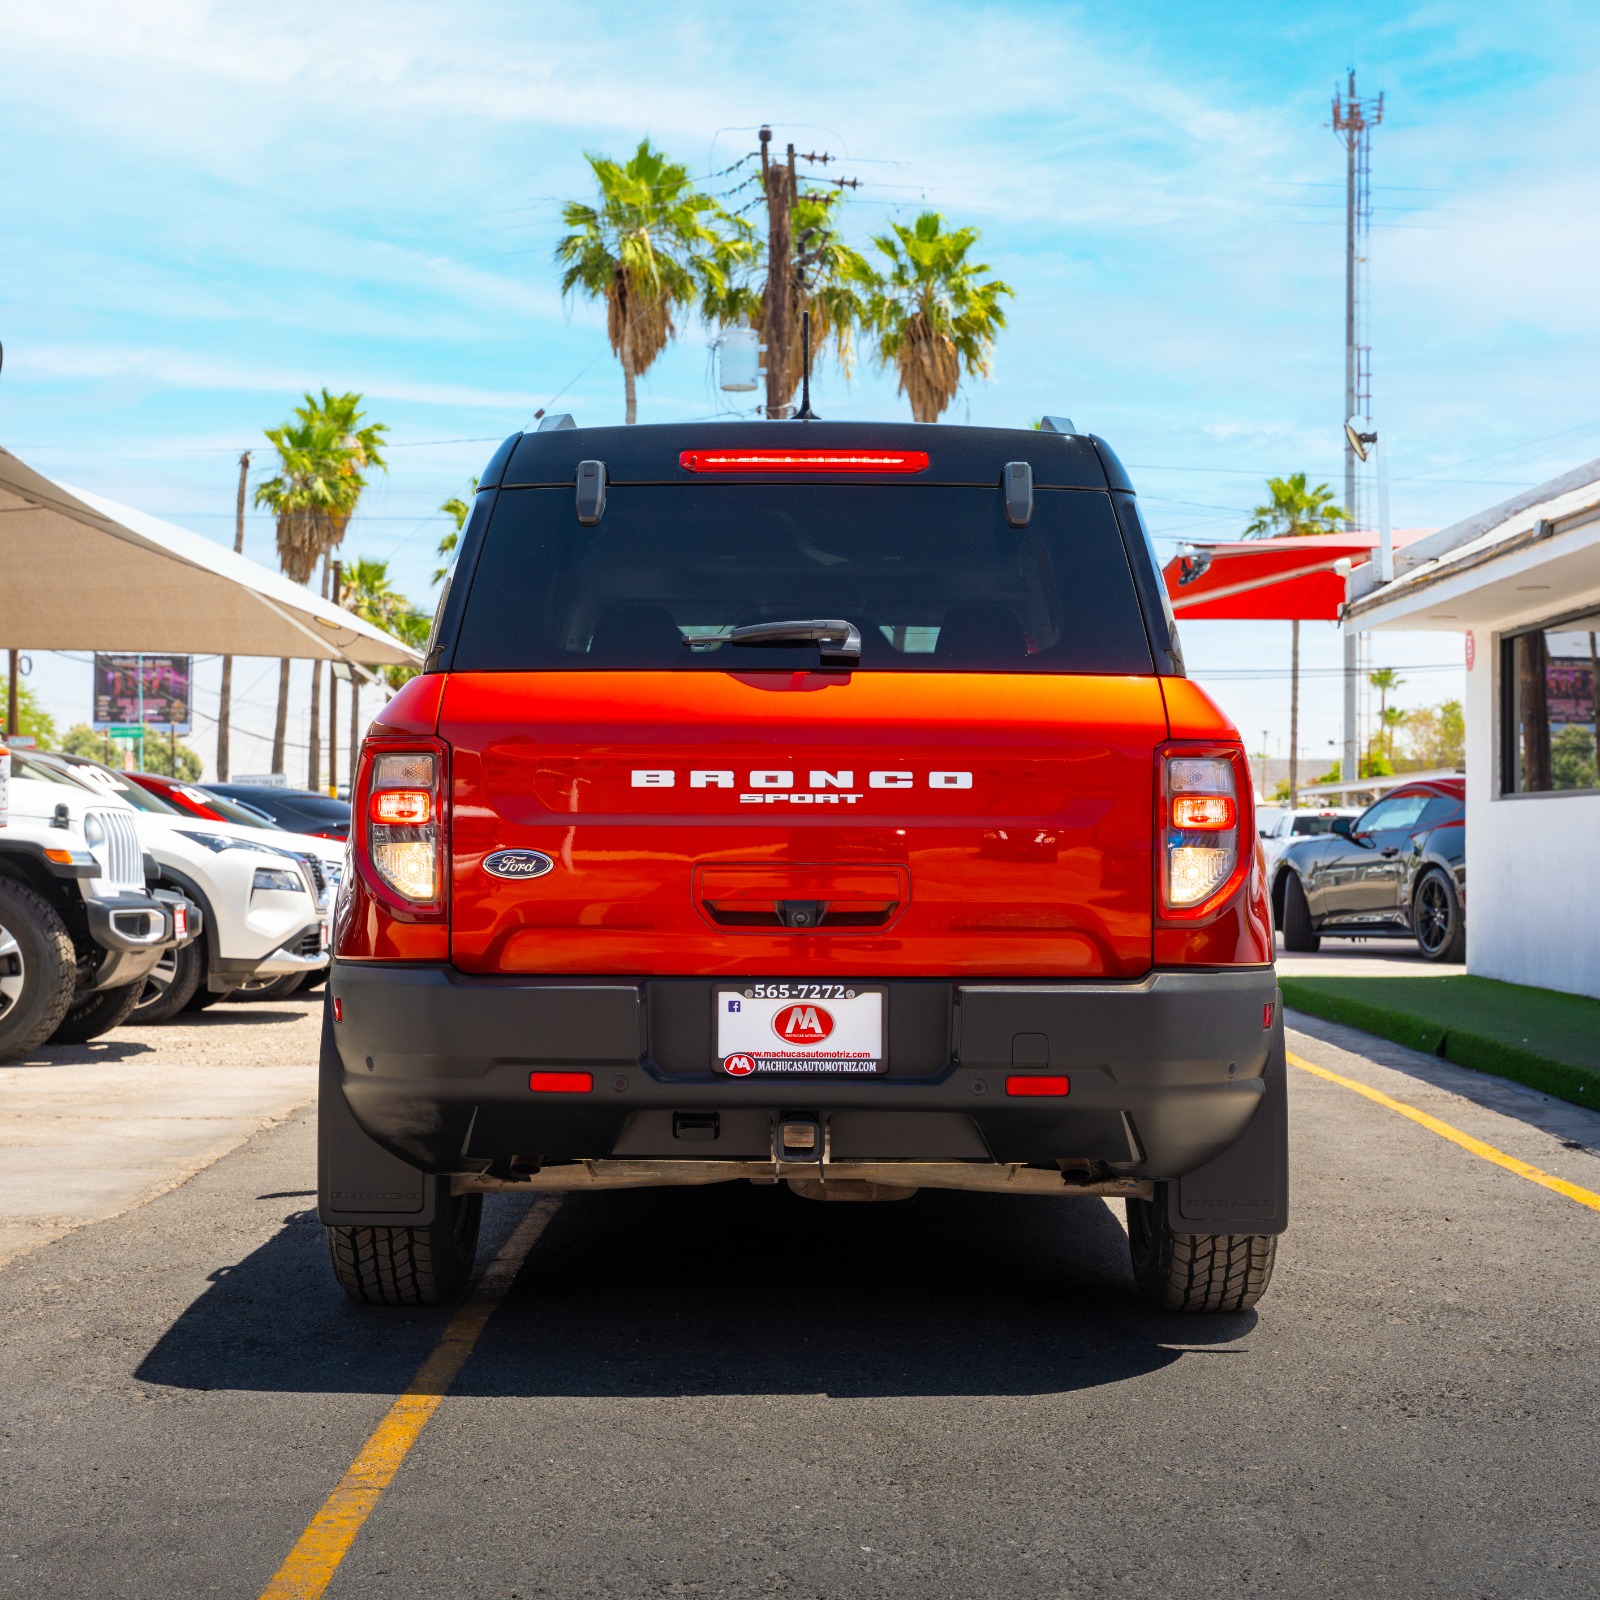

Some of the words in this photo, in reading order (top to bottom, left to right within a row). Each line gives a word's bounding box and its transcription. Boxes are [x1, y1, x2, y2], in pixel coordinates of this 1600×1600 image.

[631, 770, 973, 789] BRONCO
[739, 793, 864, 804] SPORT
[498, 855, 536, 872] Ford
[754, 984, 845, 999] 565-7272
[744, 1050, 871, 1058] ww.machucasautomotriz.com
[757, 1060, 877, 1072] MACHUCASAUTOMOTRIZ.COM
